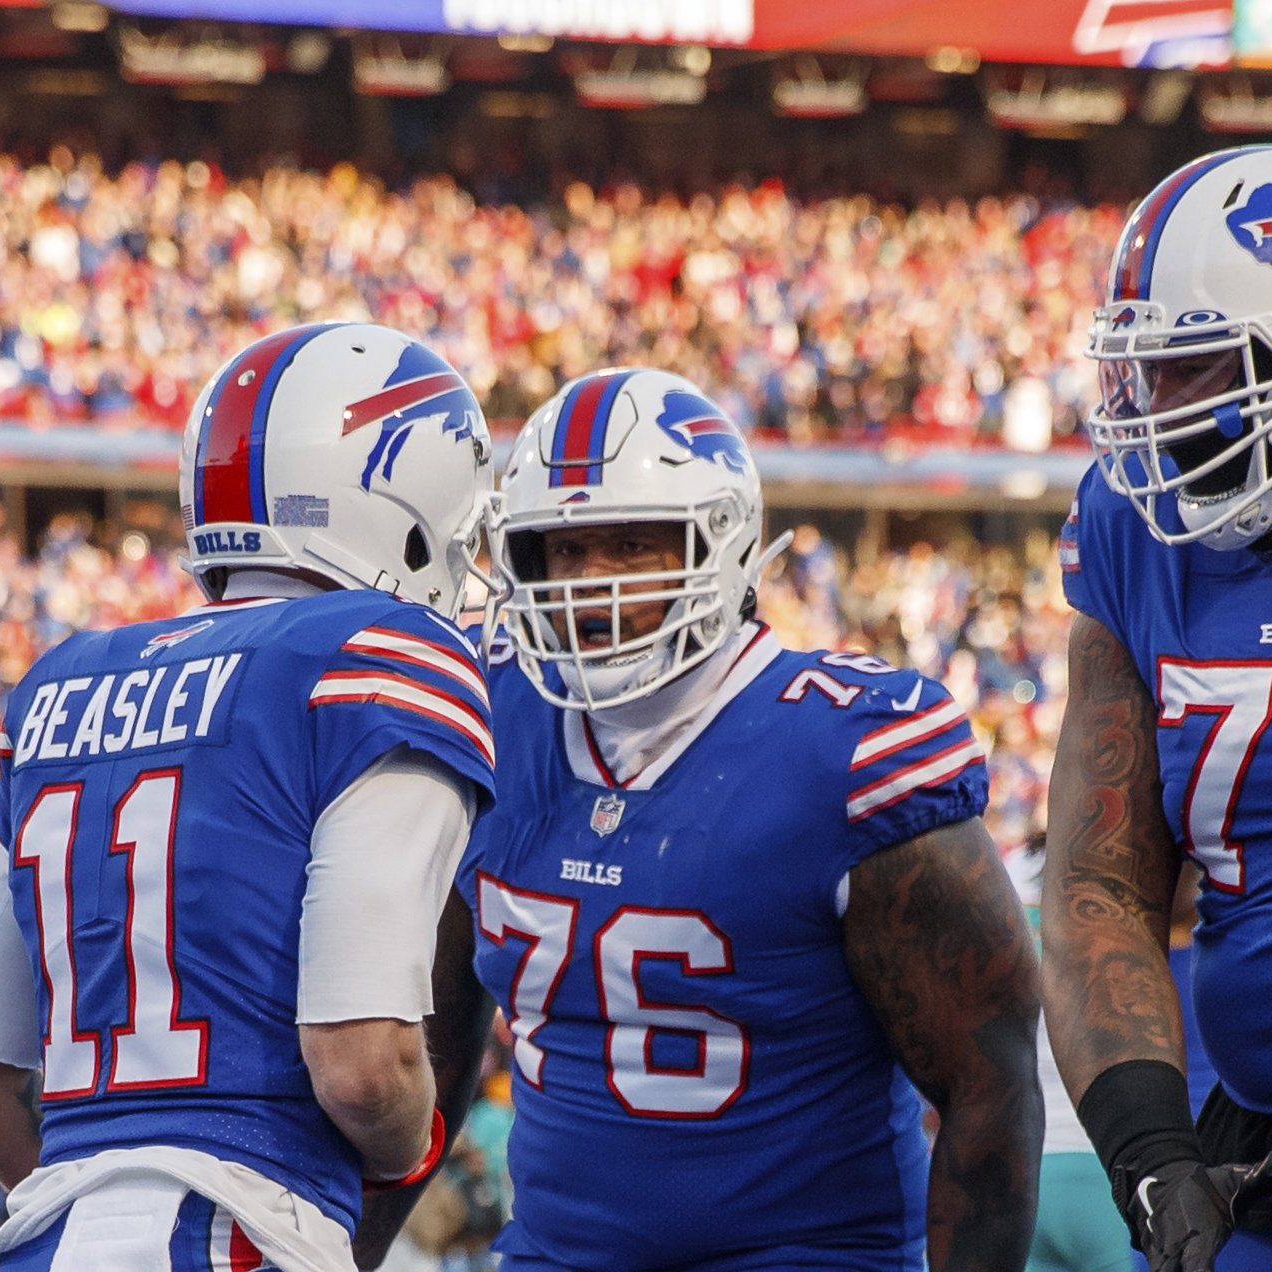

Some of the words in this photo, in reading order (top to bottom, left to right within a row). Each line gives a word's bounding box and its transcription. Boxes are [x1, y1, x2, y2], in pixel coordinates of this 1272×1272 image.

[194, 531, 261, 555] BILLS
[13, 653, 243, 769] BEASLEY
[560, 858, 623, 886] BILLS
[16, 770, 209, 1101] 11
[477, 873, 751, 1120] 76
